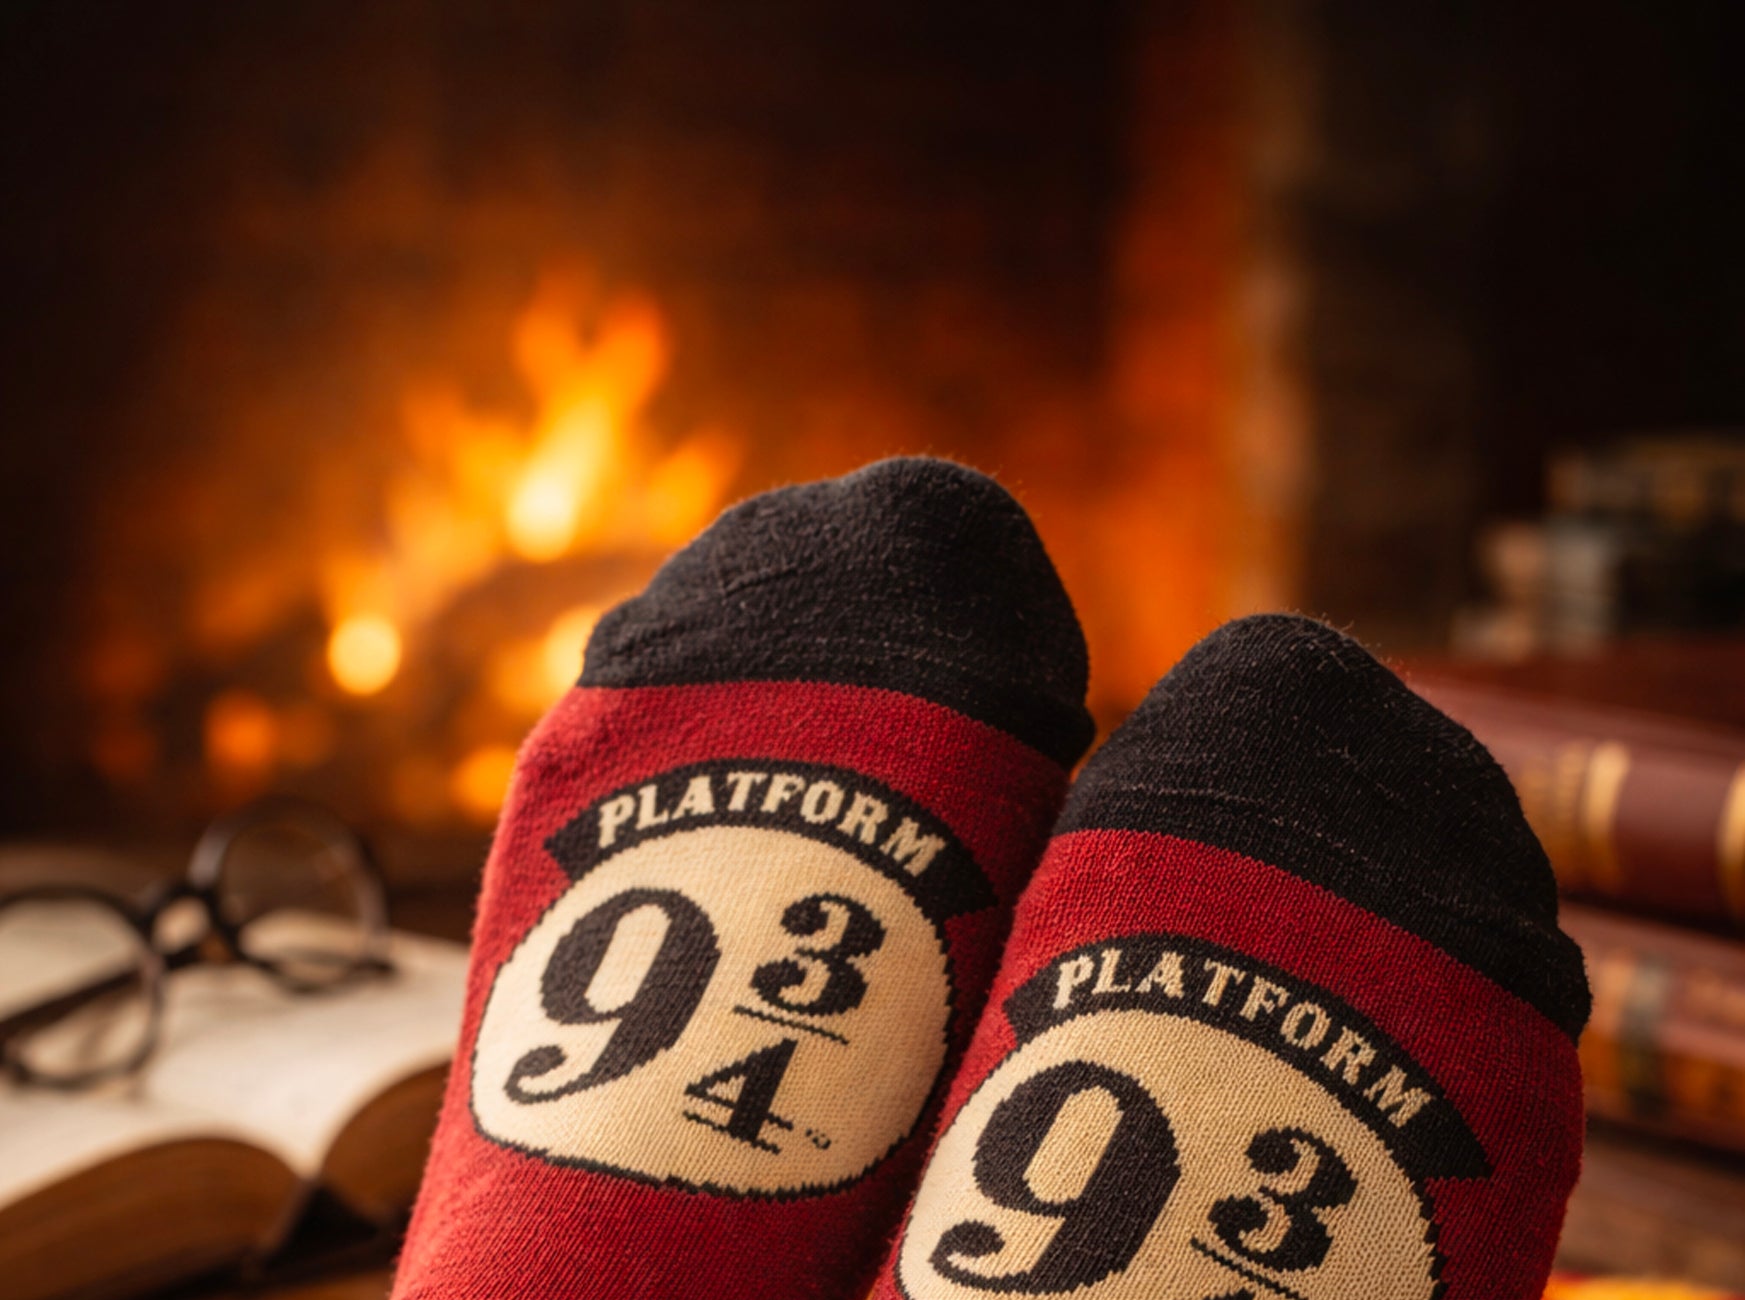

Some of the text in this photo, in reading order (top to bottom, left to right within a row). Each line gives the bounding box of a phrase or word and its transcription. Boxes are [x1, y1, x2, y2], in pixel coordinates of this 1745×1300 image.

[597, 770, 946, 878] PLATFORM
[503, 886, 721, 1105] 9
[1052, 947, 1433, 1129] PLATFORM
[927, 1060, 1181, 1296] 9
